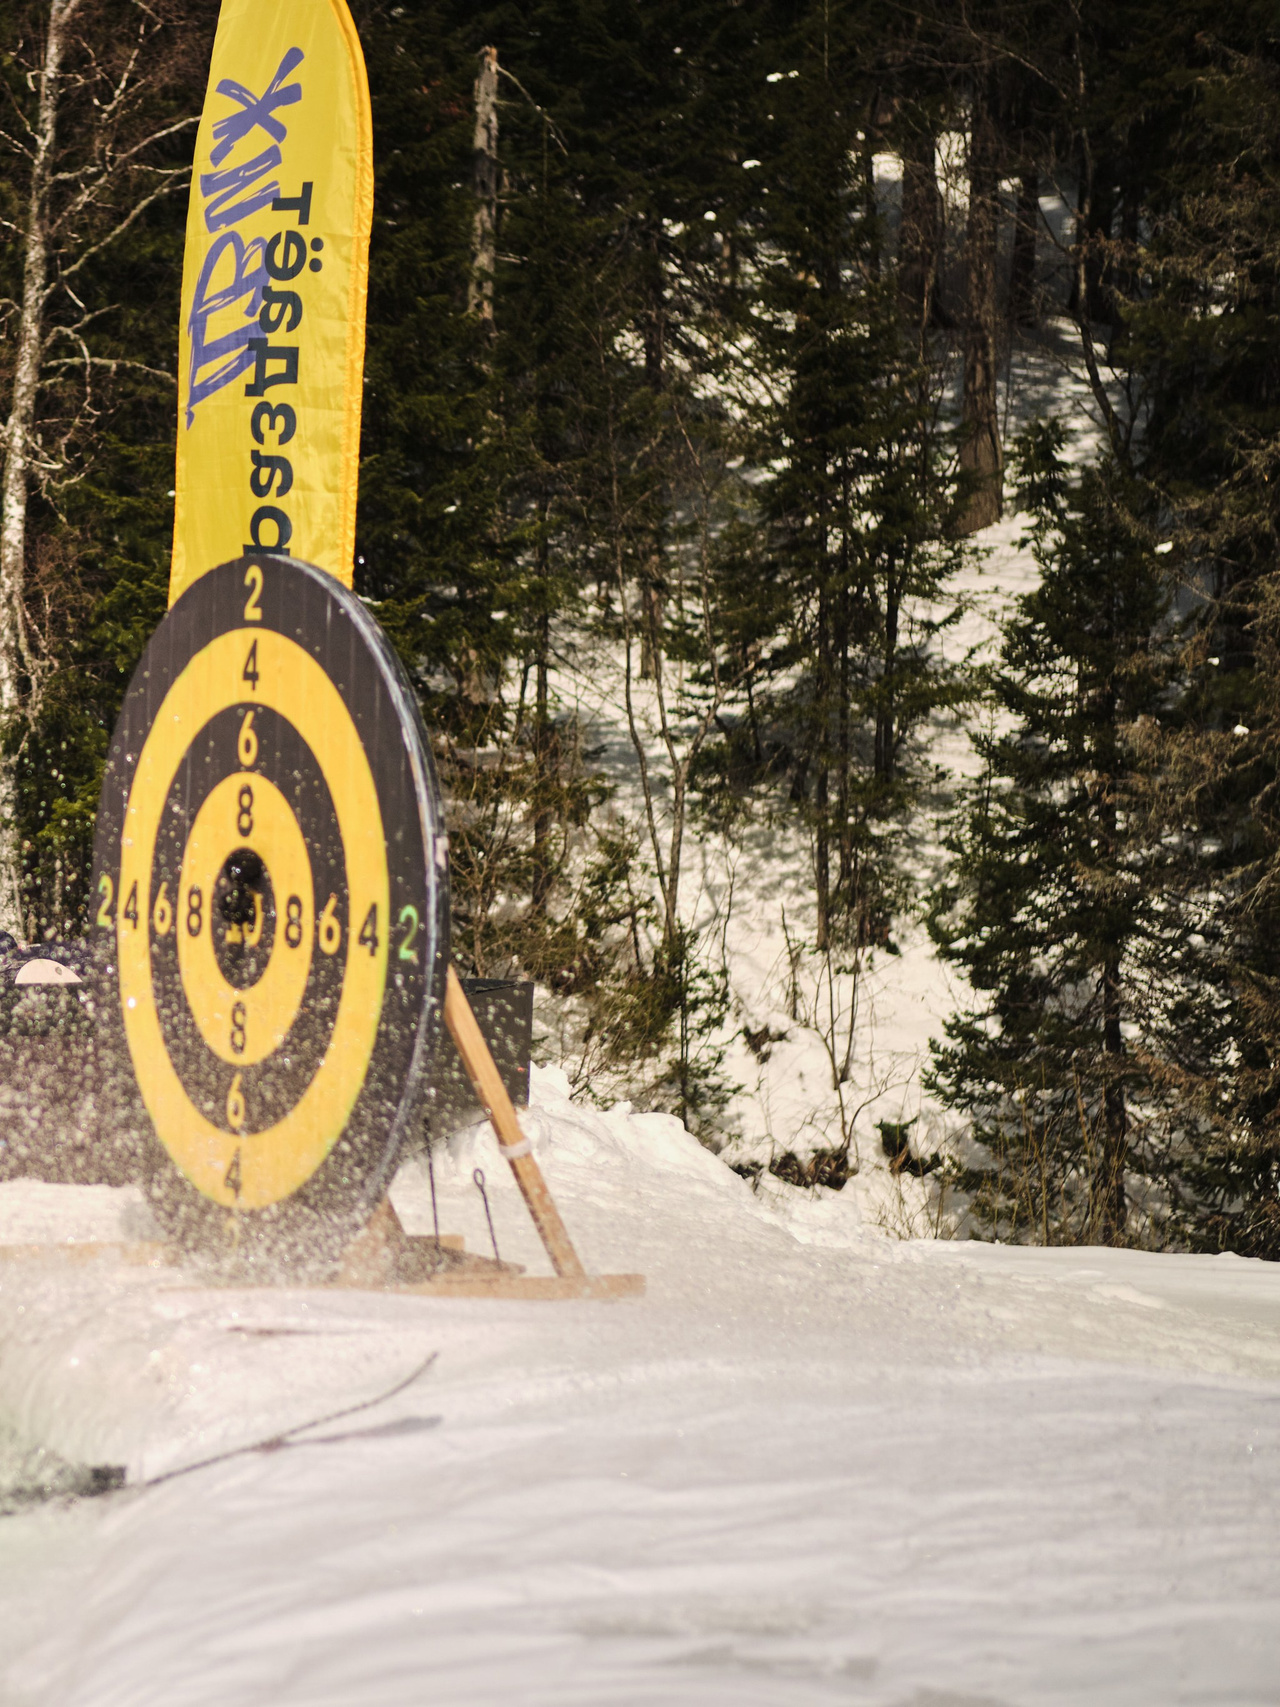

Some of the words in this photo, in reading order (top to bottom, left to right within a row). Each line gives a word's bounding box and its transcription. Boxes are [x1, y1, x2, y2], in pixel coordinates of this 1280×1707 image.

[243, 564, 263, 621] 2
[242, 637, 260, 691] 4
[237, 709, 258, 767] 6
[236, 783, 254, 838] 8
[97, 874, 114, 927] 2
[123, 879, 140, 930] 4
[152, 881, 172, 936] 6
[186, 887, 203, 938] 8
[284, 894, 303, 949] 8
[319, 893, 341, 955] 6
[358, 901, 379, 957] 4
[398, 904, 418, 960] 2
[229, 1000, 247, 1055] 8
[226, 1073, 245, 1129] 6
[224, 1145, 243, 1201] 4
